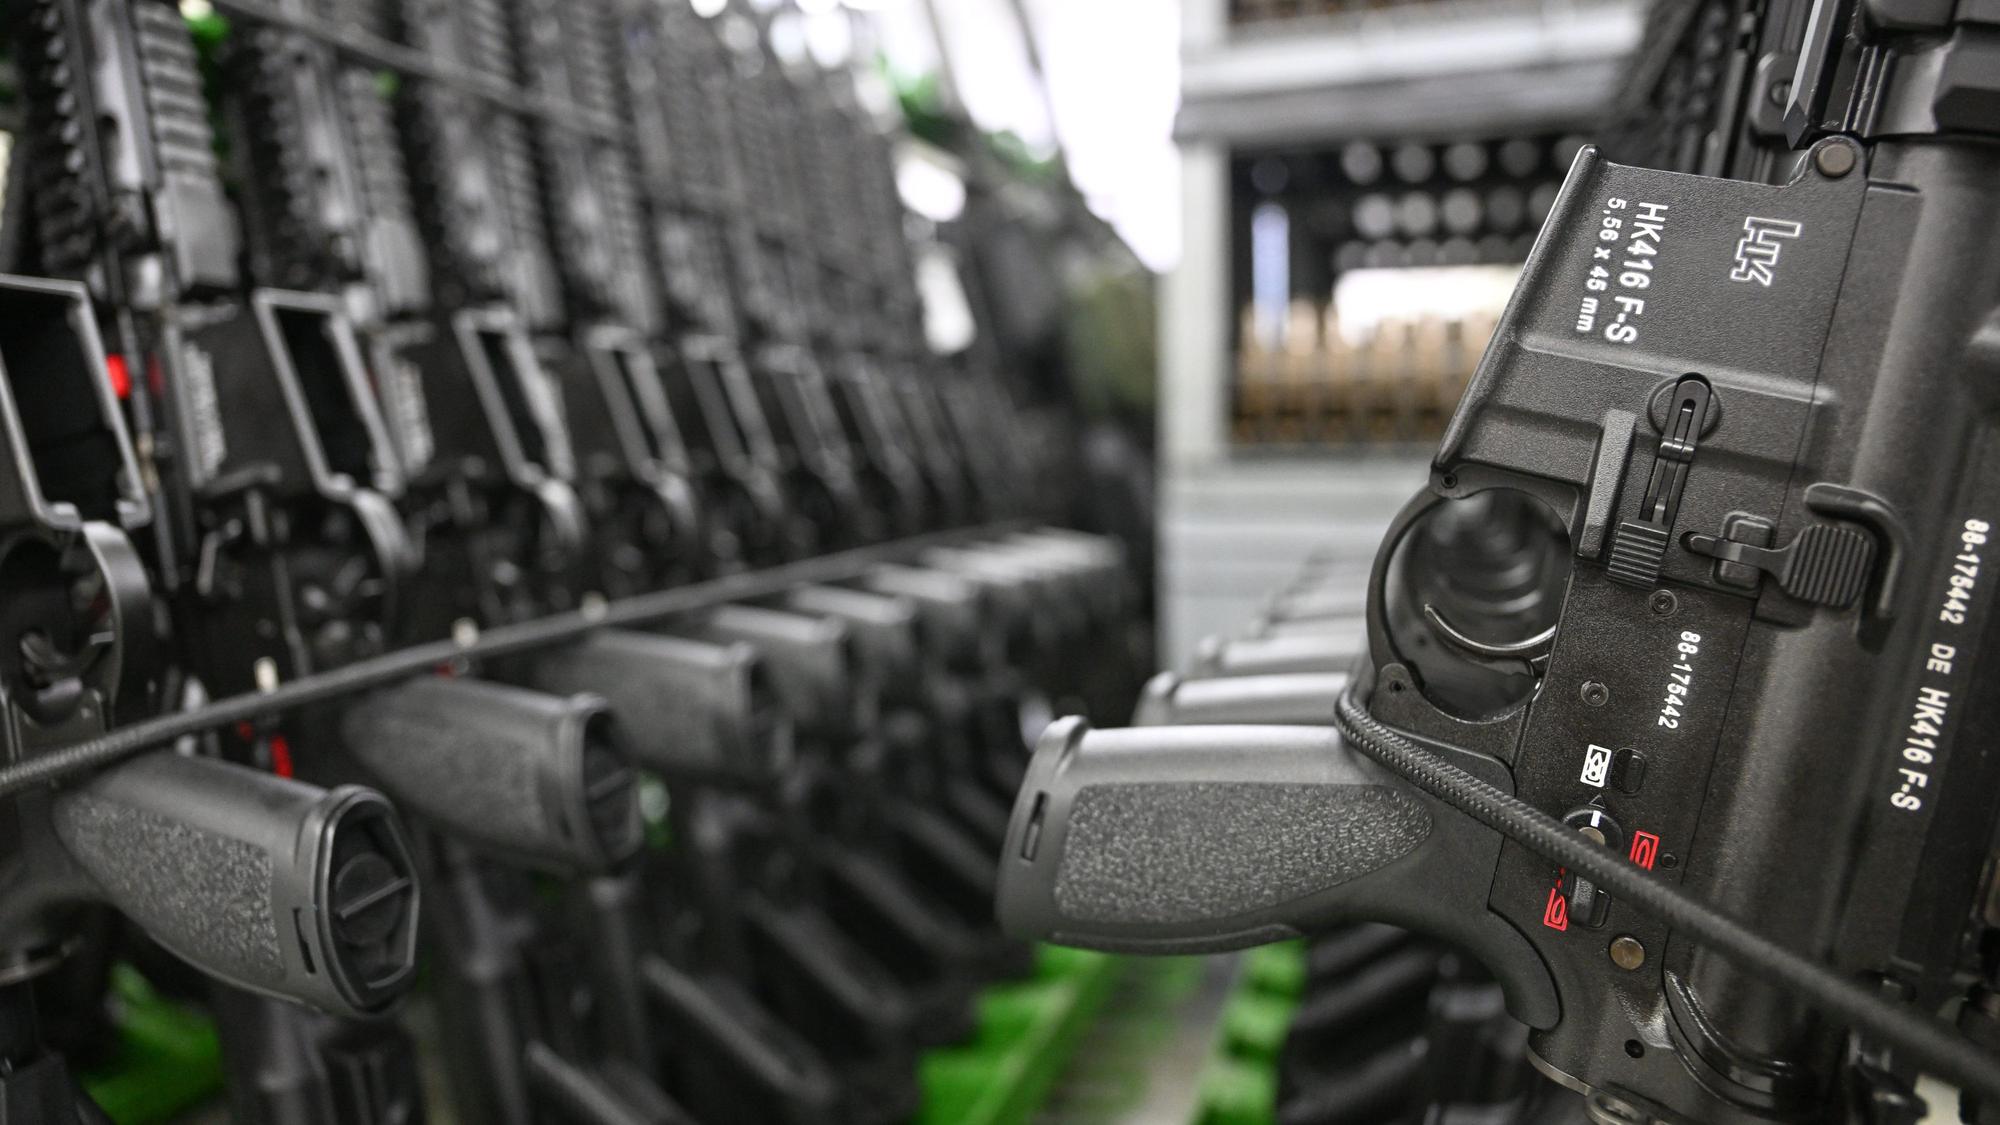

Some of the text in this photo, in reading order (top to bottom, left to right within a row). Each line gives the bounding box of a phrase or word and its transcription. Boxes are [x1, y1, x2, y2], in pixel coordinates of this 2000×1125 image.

[1585, 265, 1610, 292] 45
[1593, 246, 1612, 260] x
[1604, 201, 1669, 343] HK416 F-S
[1730, 216, 1802, 287] HK
[1575, 296, 1599, 332] mm
[1657, 630, 1702, 729] 88-175442
[1890, 518, 1990, 811] 88-175442 DE HK416 F-S
